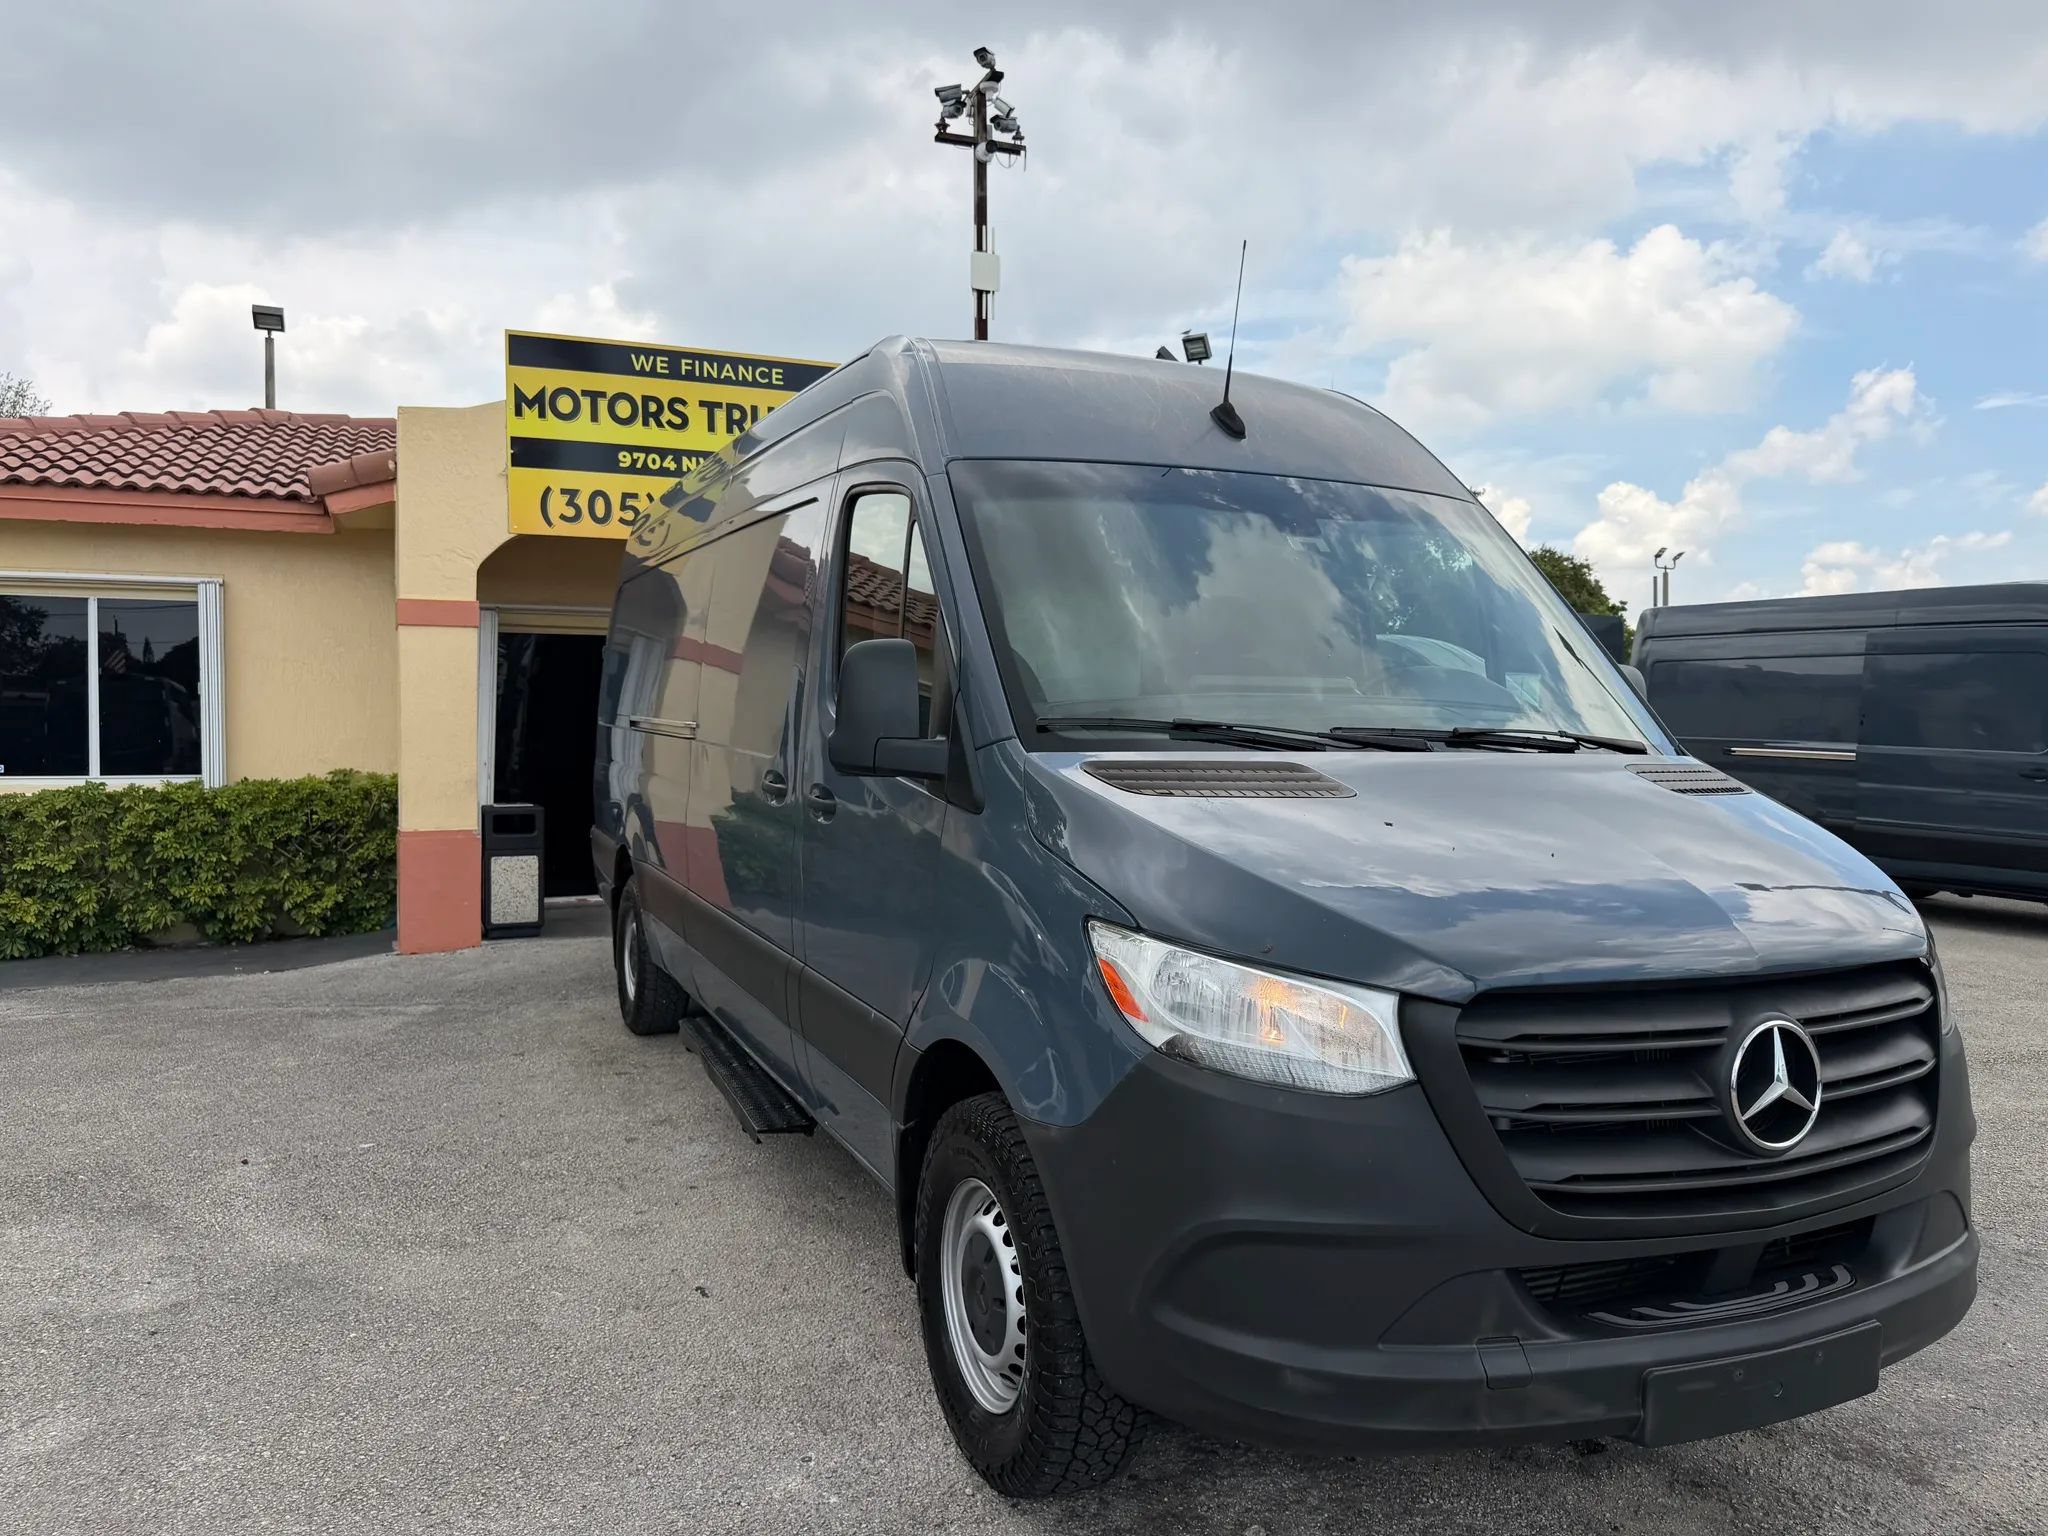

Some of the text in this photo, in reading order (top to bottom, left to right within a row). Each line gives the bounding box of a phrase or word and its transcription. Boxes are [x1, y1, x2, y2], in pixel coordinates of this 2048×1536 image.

[631, 353, 784, 385] WE FINANCE
[514, 383, 690, 431] MOTORS
[618, 451, 705, 472] 9704 N
[540, 486, 655, 528] (305
